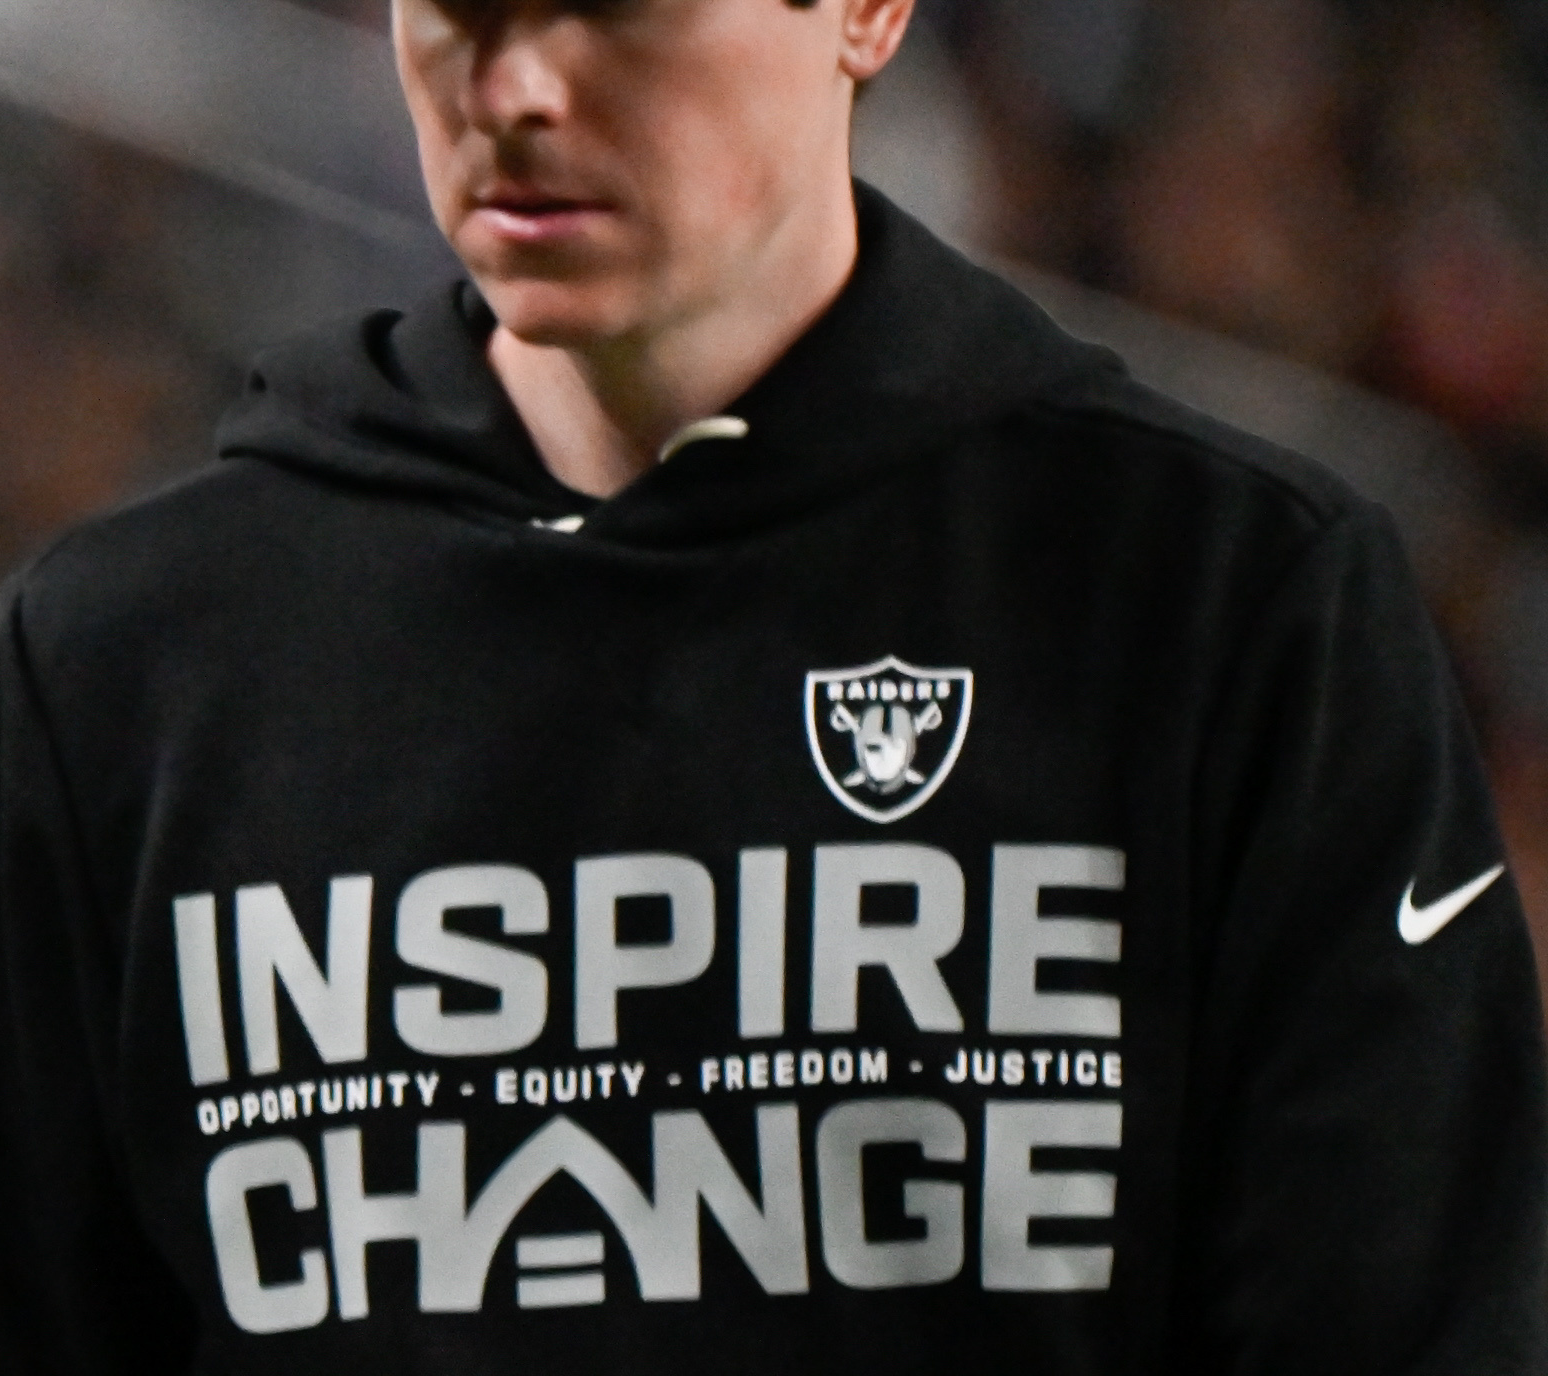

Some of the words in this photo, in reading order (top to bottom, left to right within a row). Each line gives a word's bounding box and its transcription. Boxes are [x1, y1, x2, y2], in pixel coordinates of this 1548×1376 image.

[172, 842, 1127, 1086] INSPIRE
[198, 1070, 440, 1137] OPPORTUNITY
[494, 1060, 646, 1106] EQUITY
[700, 1049, 890, 1095] FREEDOM
[944, 1048, 1123, 1090] JUSTICE
[205, 1099, 1124, 1336] CHANGE
